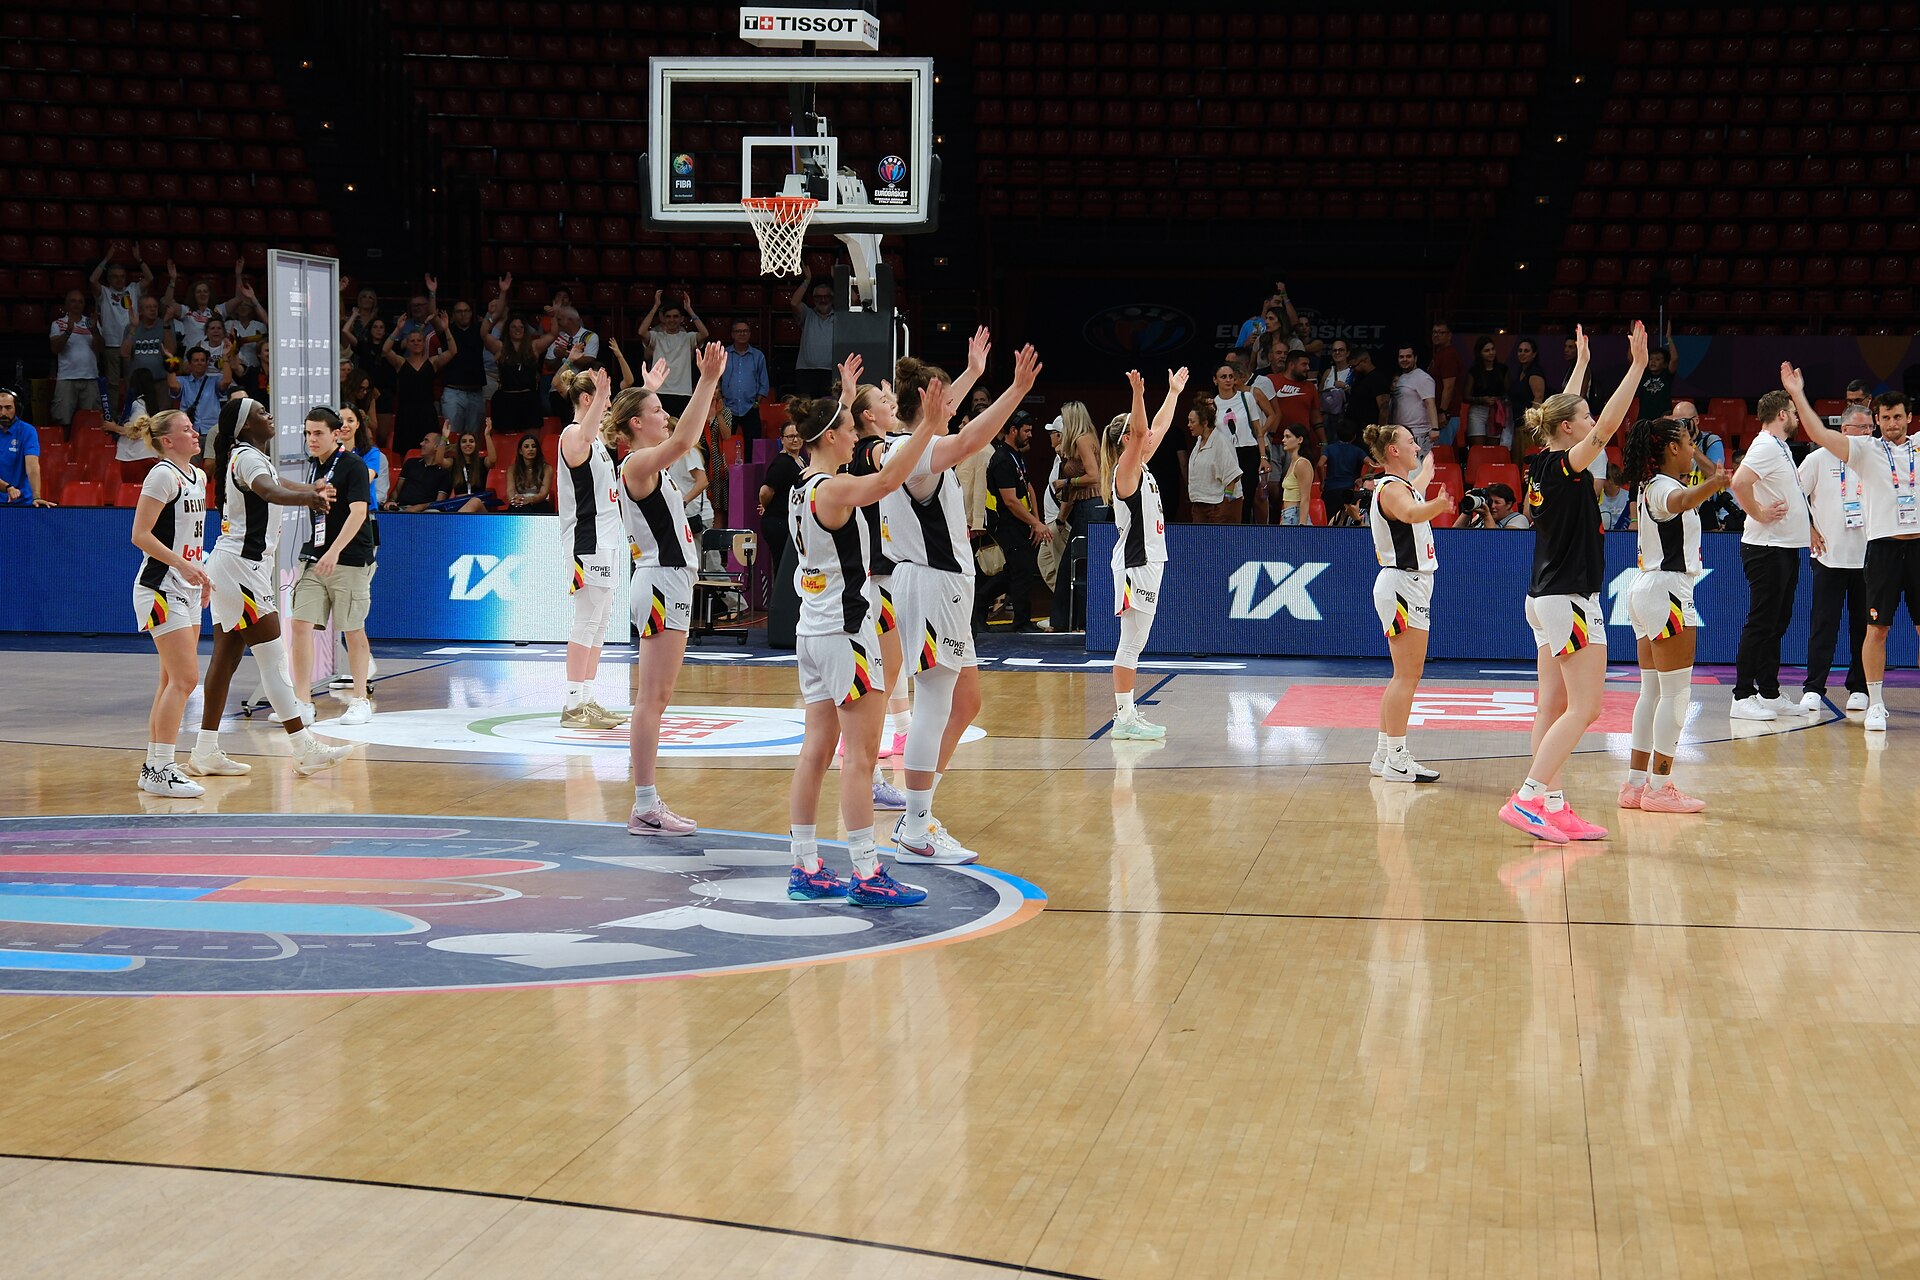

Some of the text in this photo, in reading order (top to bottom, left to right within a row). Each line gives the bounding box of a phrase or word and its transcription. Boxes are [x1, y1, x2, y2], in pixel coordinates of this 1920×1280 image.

[776, 16, 858, 32] TISSOT
[675, 180, 692, 189] FIBA
[135, 339, 160, 355] BOSS
[1281, 384, 1301, 394] NIKE
[1228, 561, 1331, 620] 1X
